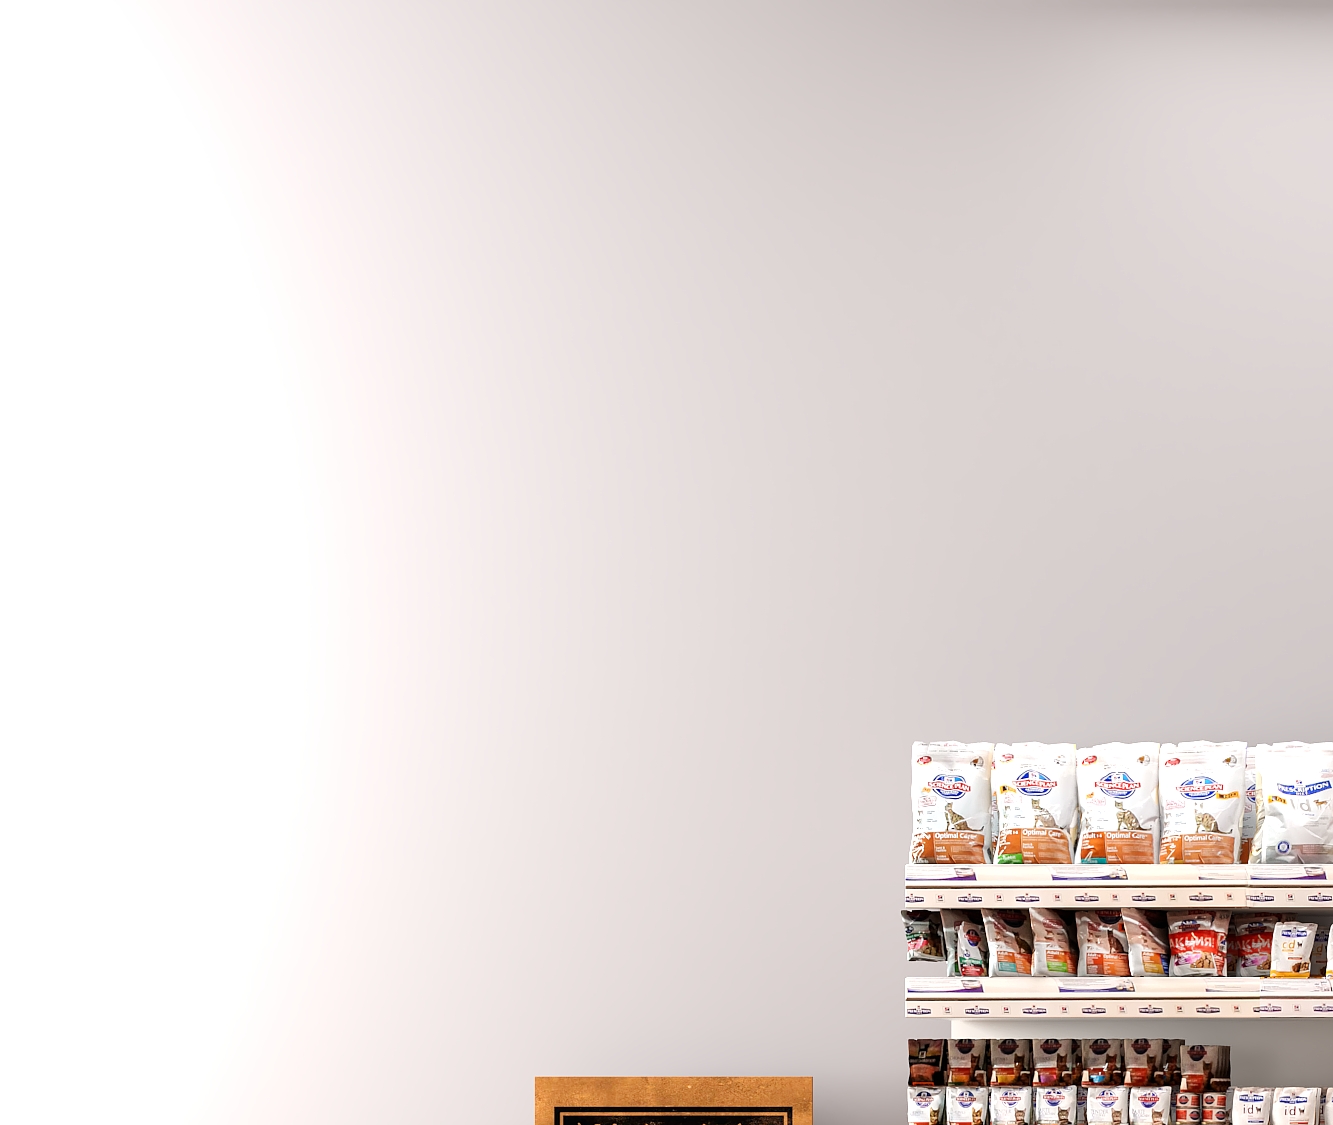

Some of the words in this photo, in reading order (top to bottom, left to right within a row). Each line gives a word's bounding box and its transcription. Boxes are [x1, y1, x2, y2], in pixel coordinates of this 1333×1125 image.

[934, 832, 958, 840] Optimal
[1022, 829, 1047, 837] Optimal
[1106, 832, 1130, 840] Optimal
